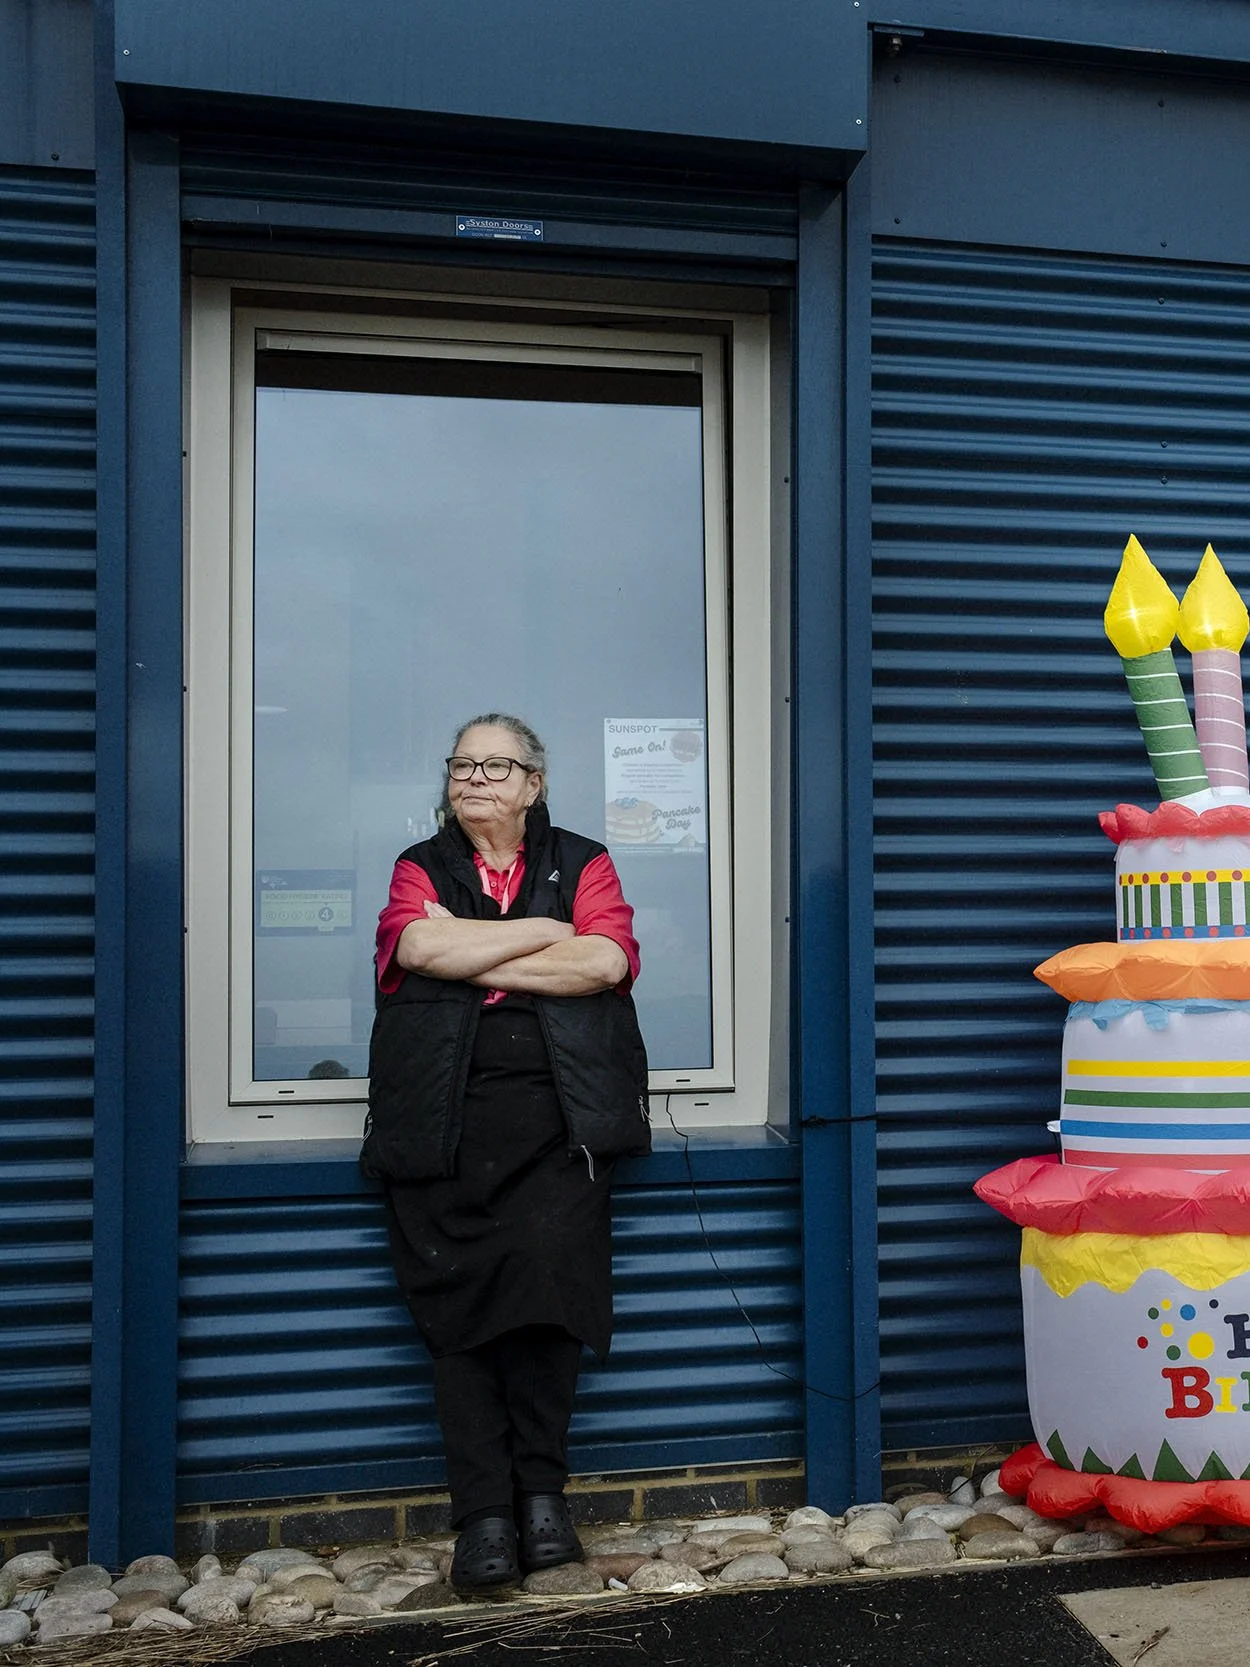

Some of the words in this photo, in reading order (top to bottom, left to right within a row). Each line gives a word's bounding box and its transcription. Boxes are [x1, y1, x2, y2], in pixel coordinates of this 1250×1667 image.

[470, 219, 500, 228] Syston
[502, 221, 529, 230] Doors
[608, 725, 657, 733] SUNSPOT
[652, 805, 701, 820] Pancake
[666, 818, 691, 830] Day
